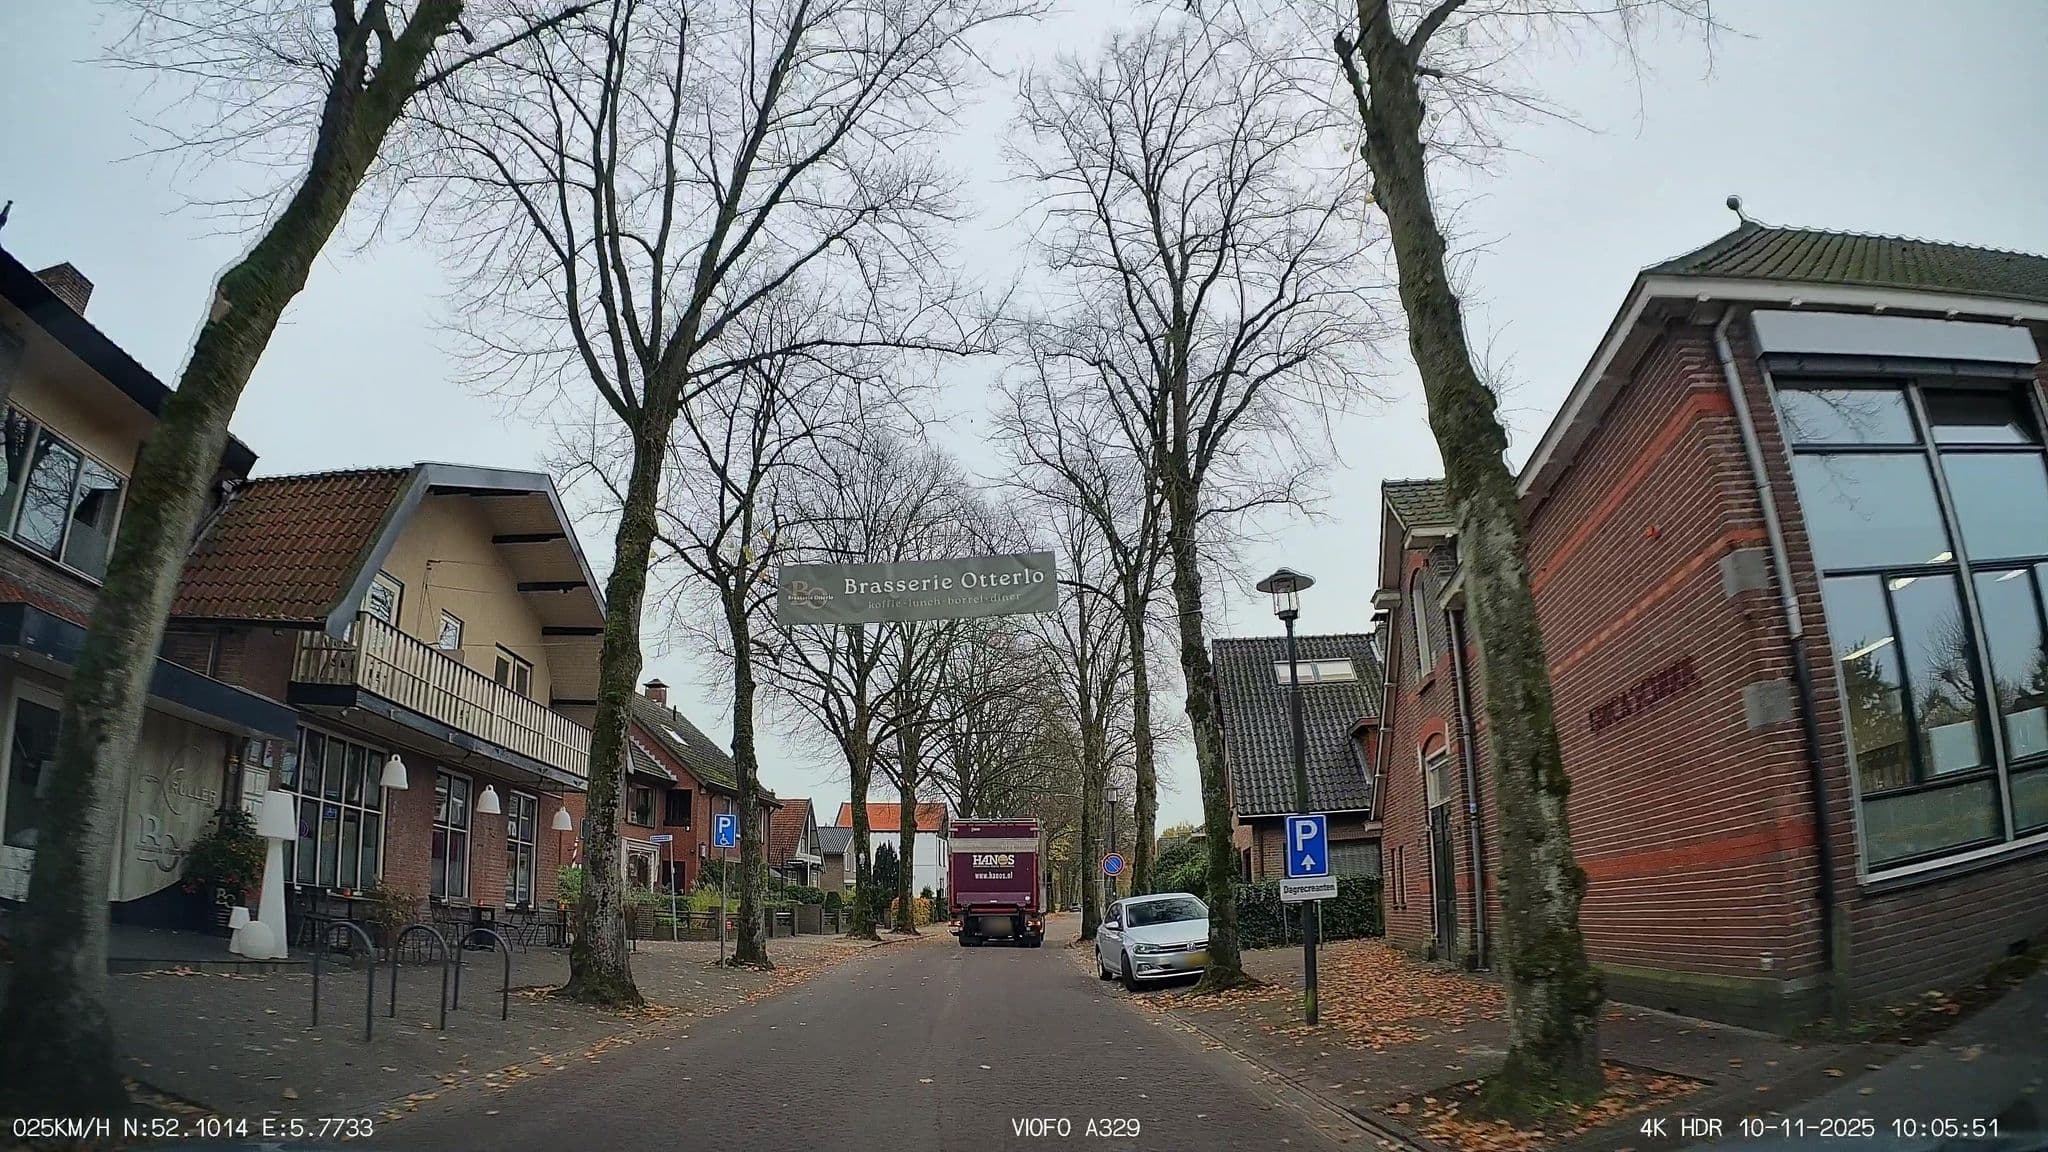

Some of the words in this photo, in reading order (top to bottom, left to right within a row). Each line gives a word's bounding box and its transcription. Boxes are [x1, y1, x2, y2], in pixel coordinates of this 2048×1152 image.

[844, 574, 953, 595] Brasserie
[961, 567, 1045, 589] Otterlo
[909, 597, 941, 608] lunch
[948, 594, 984, 605] borrel
[990, 592, 1022, 603] diner
[719, 817, 730, 833] P
[1295, 820, 1317, 851] P
[972, 855, 1014, 866] HANOS
[974, 871, 1013, 880] www.hanos.nl
[1283, 884, 1335, 895] Dagrecreanten
